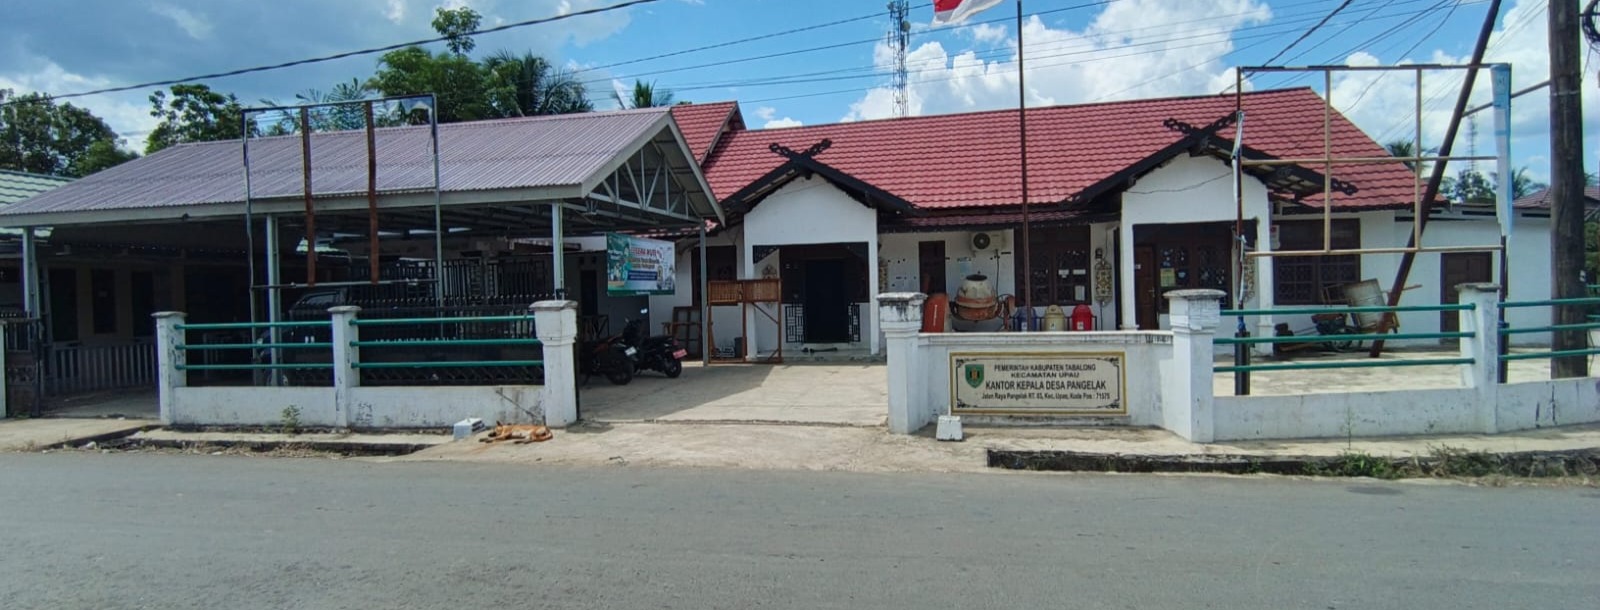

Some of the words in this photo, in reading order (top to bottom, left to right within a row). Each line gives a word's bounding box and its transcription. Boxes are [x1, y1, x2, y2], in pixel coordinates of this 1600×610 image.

[994, 364, 1029, 372] PEMERINTAH
[1030, 364, 1064, 372] KABUPATEN
[1065, 363, 1096, 372] TABALONG
[985, 380, 1015, 390] KANTOR
[1016, 380, 1044, 390] KEPALA
[1046, 380, 1065, 390] DESA
[1066, 380, 1106, 390] PANGELAK
[995, 393, 1006, 401] Raya
